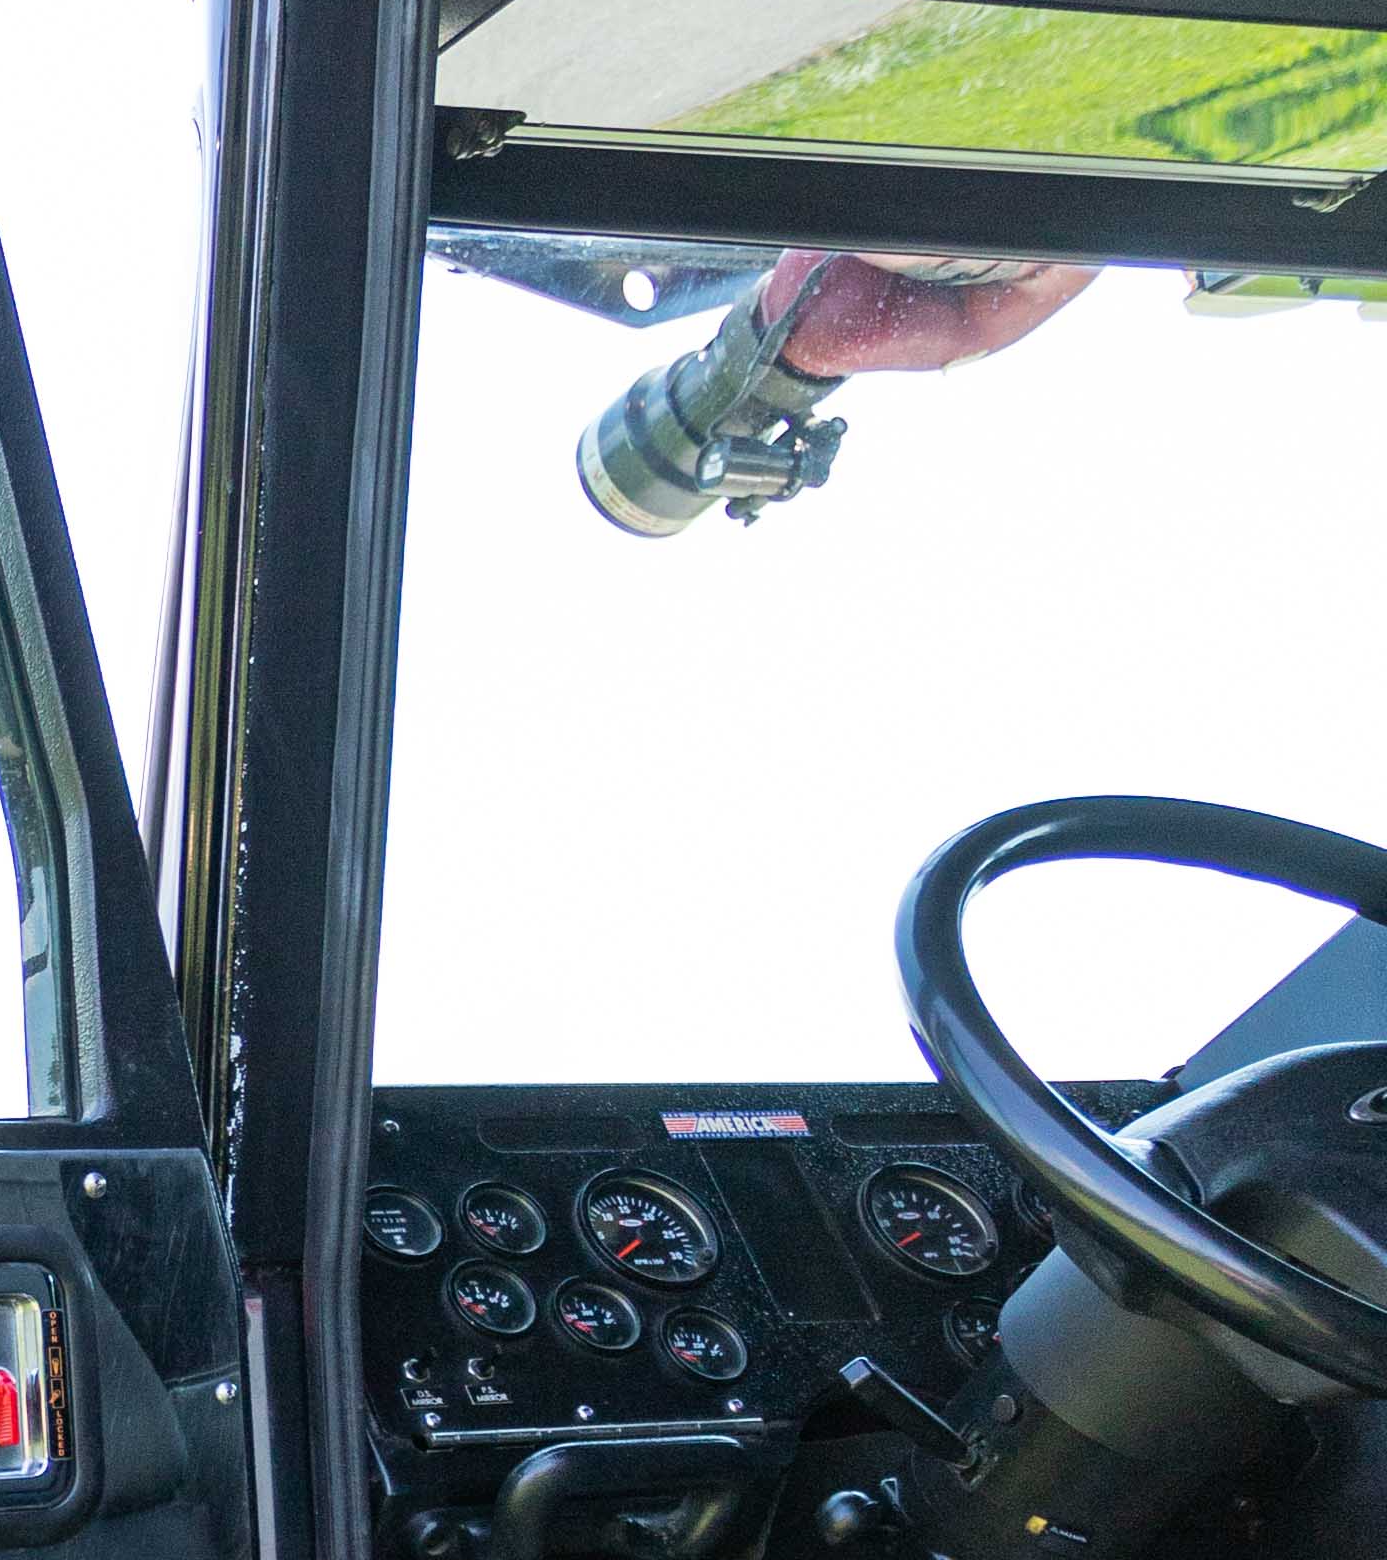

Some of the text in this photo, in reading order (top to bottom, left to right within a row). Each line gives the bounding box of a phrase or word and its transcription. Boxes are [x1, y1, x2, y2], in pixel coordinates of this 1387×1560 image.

[696, 1116, 776, 1133] AMERICA
[601, 1213, 614, 1222] 10
[662, 1230, 676, 1239] 25
[49, 1311, 59, 1343] OPEN
[55, 1410, 65, 1457] LOCKED
